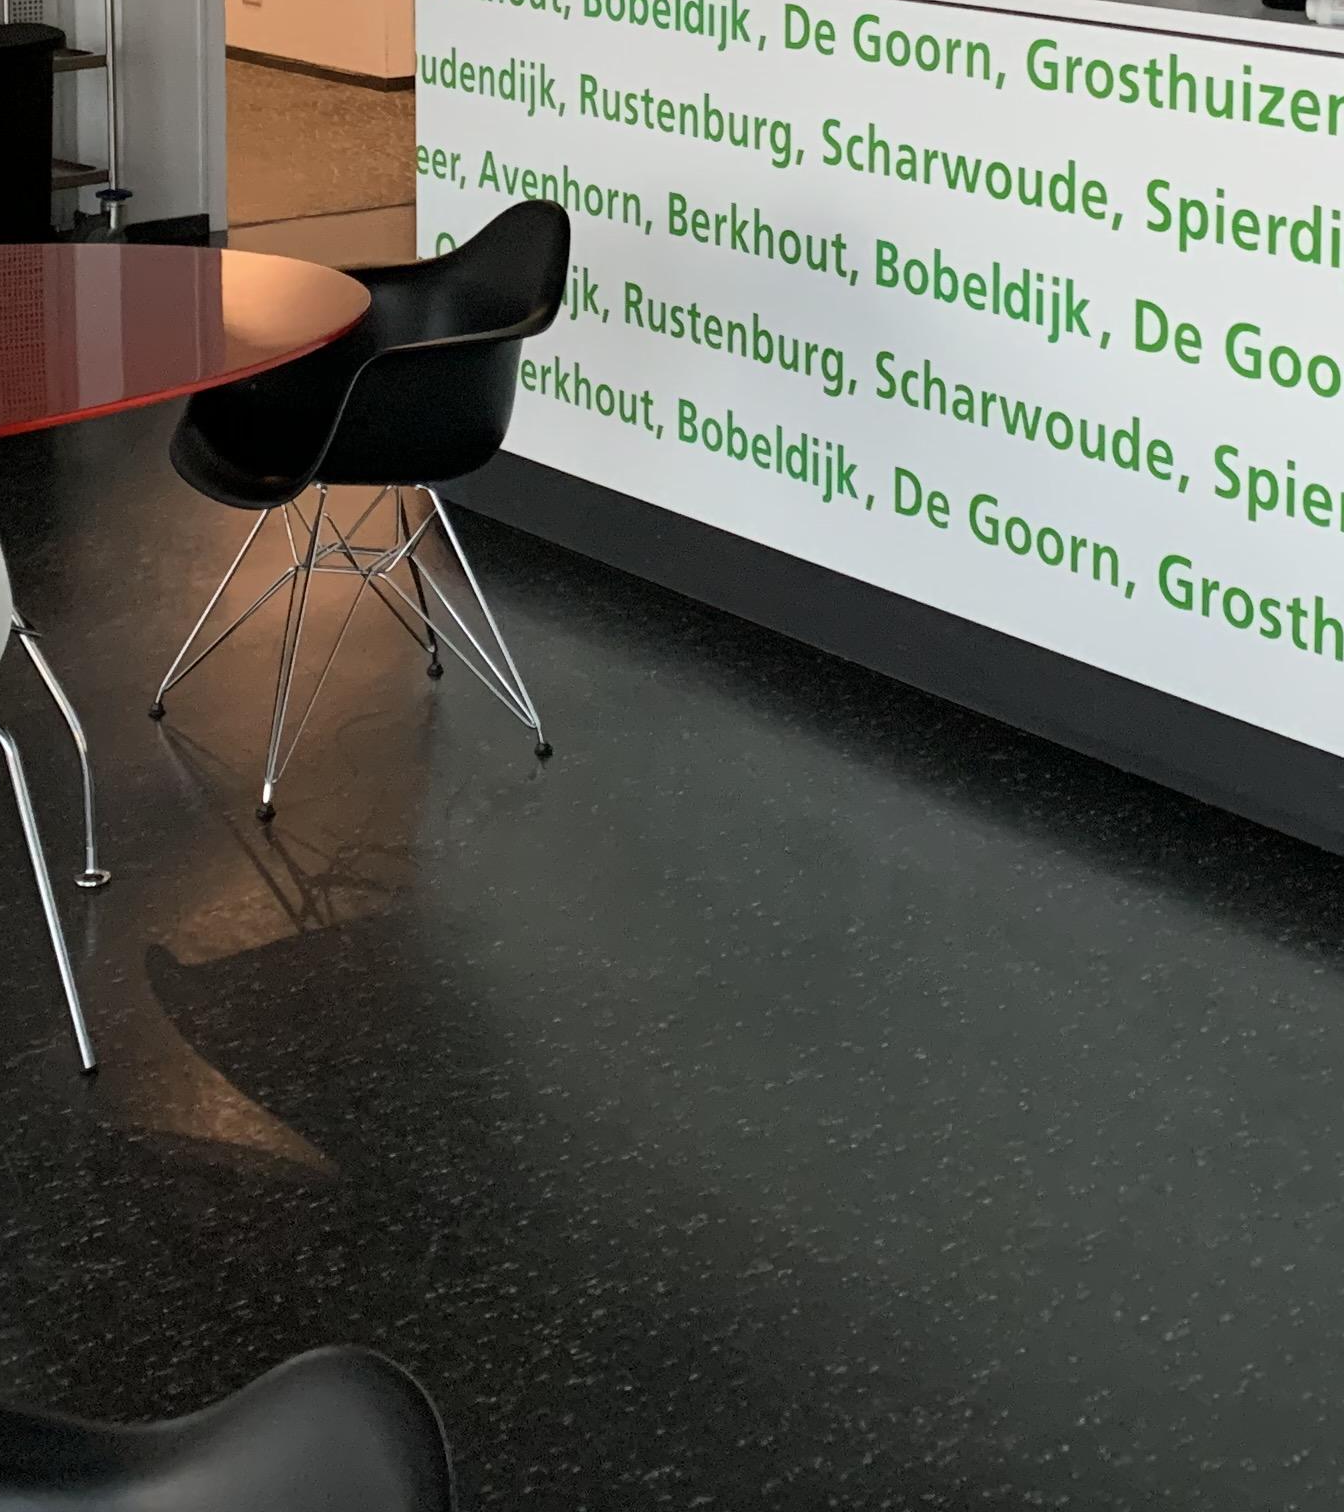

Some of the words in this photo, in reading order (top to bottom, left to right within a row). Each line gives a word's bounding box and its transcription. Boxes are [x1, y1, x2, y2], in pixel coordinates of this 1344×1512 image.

[417, 47, 566, 118] udendijk,
[581, 74, 804, 168] Rustenburg,
[823, 119, 1122, 230] Scharwoude,
[785, 4, 835, 55] De
[854, 14, 1005, 89] Goorn,
[478, 151, 652, 235] Avenhorn,
[669, 192, 858, 286] Berkhout,
[1136, 299, 1201, 364] De
[520, 357, 665, 440] erkhout,
[895, 467, 950, 529] De
[969, 494, 1135, 599] Goorn,
[625, 281, 857, 397] Rustenburg,
[876, 351, 1189, 493] Scharwoude,
